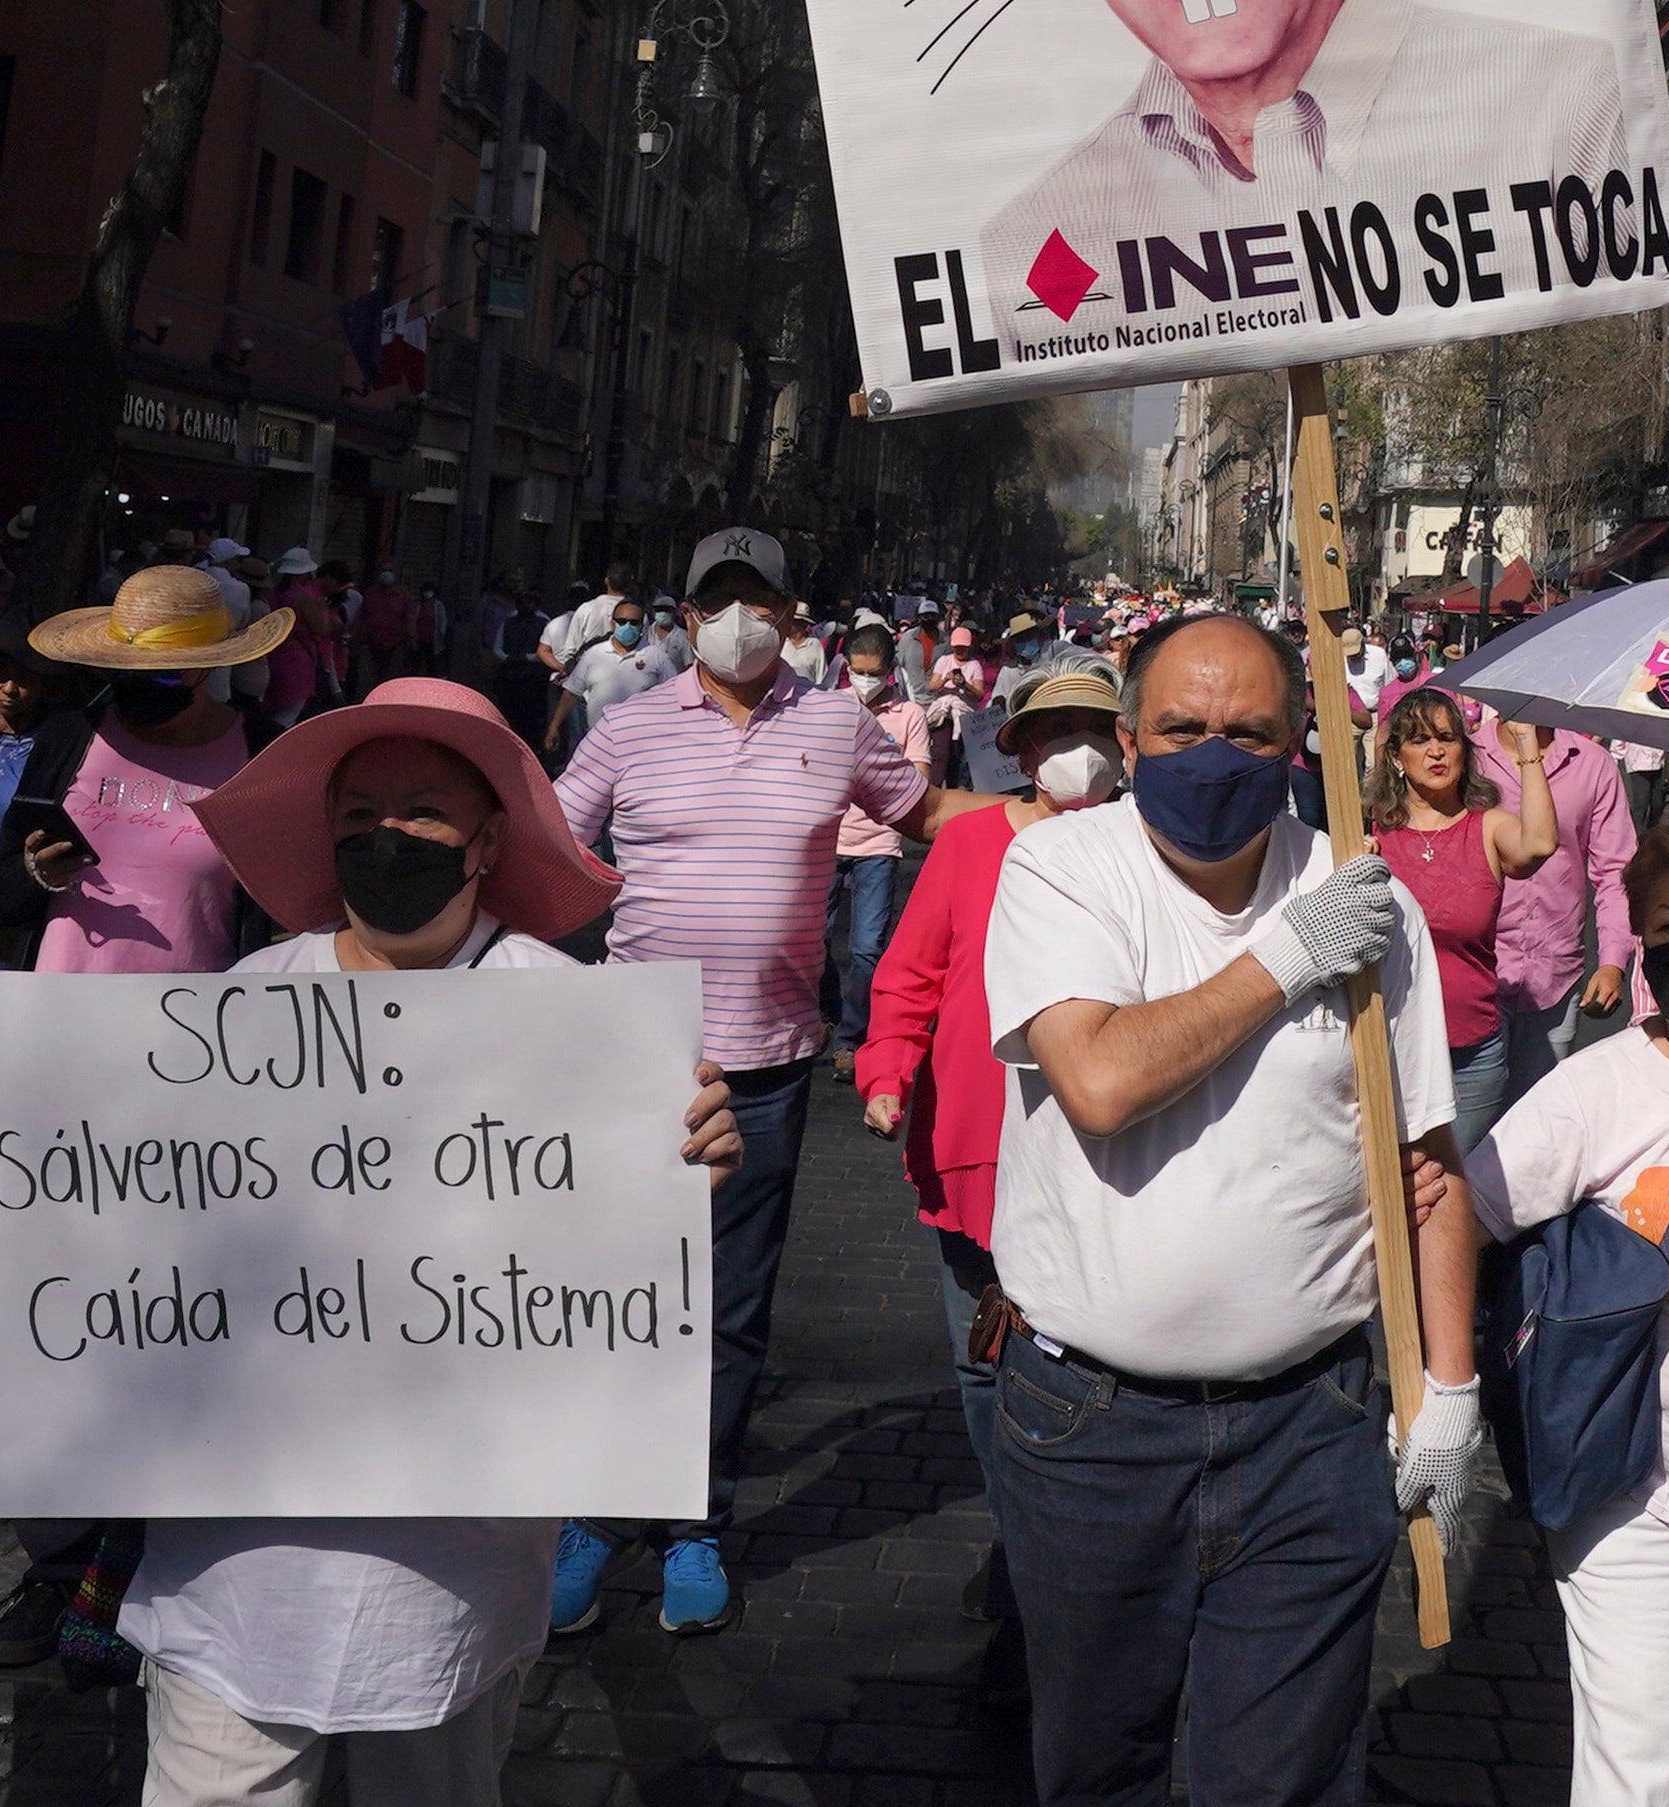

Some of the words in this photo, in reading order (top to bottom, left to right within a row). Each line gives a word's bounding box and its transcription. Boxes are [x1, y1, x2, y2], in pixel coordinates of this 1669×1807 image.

[893, 249, 1001, 382] EL
[1116, 223, 1301, 314] INE
[1296, 202, 1401, 323] NO
[1415, 189, 1504, 307] SE
[1016, 329, 1110, 362] Instituto
[1116, 316, 1210, 348] Nacional
[1217, 301, 1306, 334] Electoral
[122, 393, 165, 432] UGOS
[183, 408, 239, 446] CANADA
[147, 980, 404, 1095] SCJN:
[311, 1124, 392, 1196] de
[434, 1111, 576, 1201] otra
[28, 1265, 230, 1362] Caída
[273, 1257, 370, 1344] del
[400, 1236, 695, 1353] Sistema!
